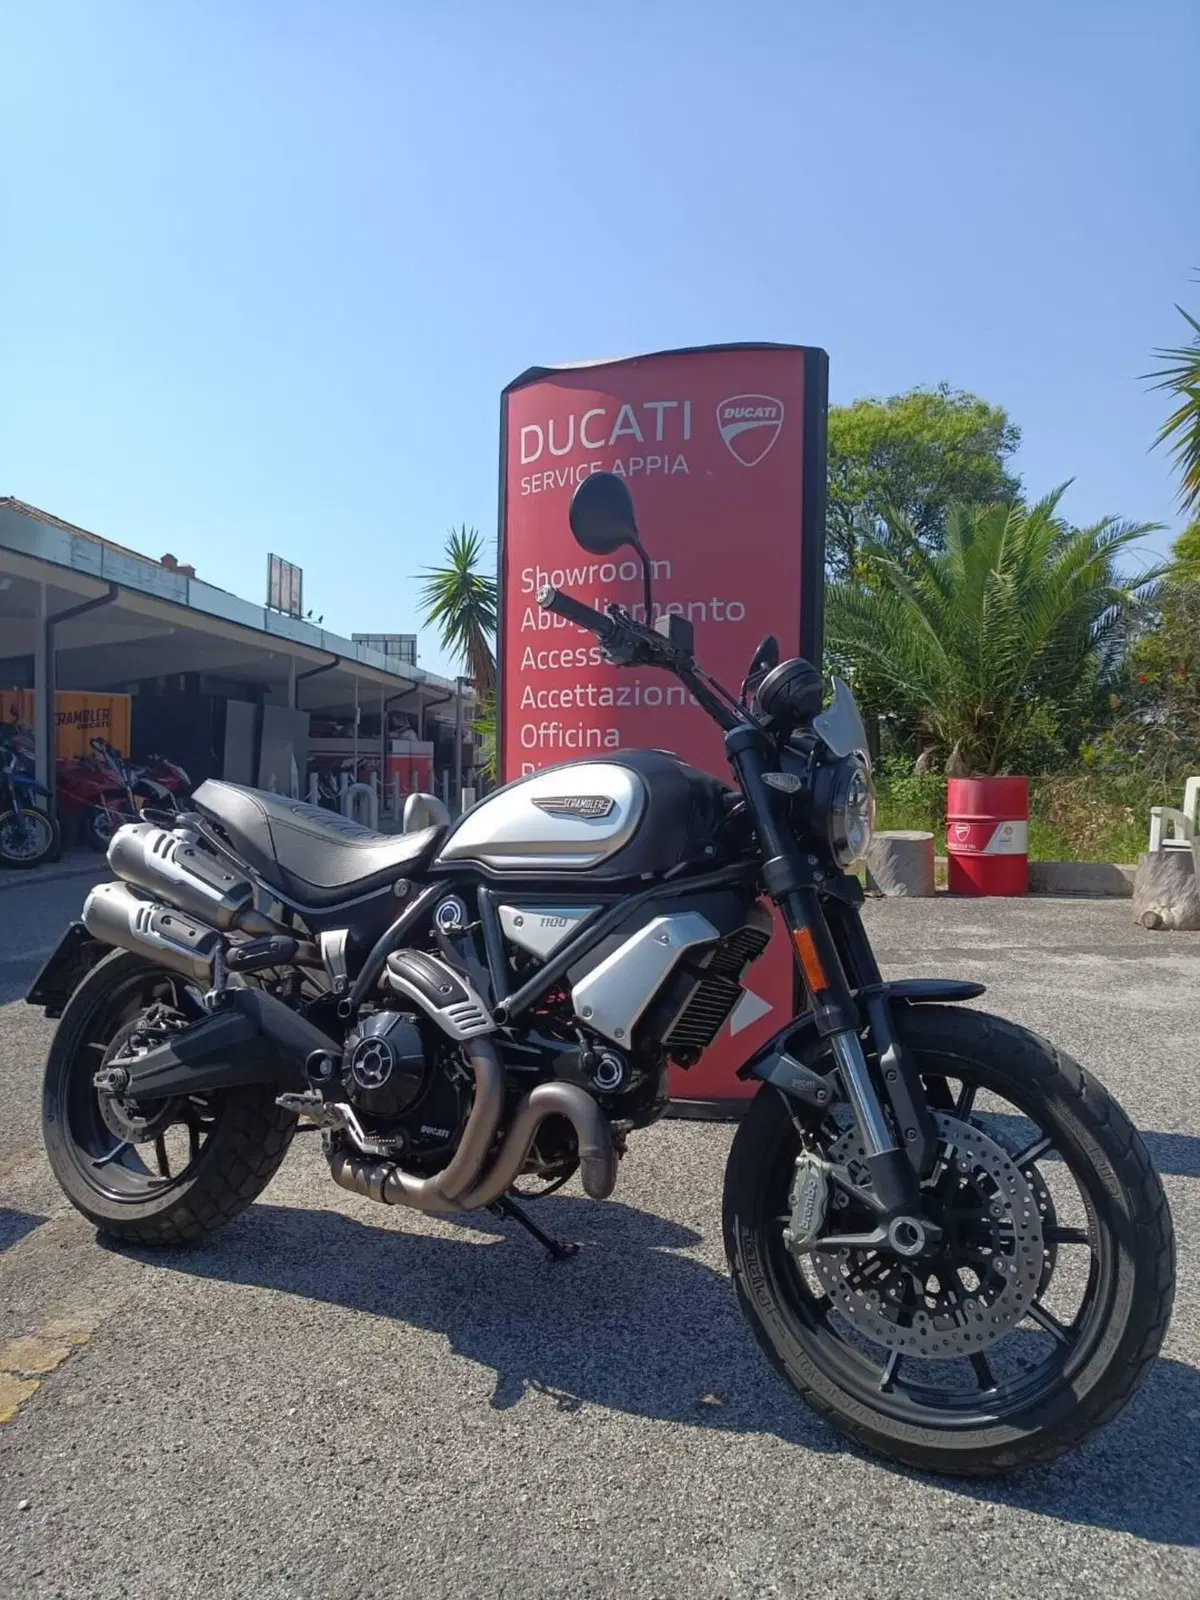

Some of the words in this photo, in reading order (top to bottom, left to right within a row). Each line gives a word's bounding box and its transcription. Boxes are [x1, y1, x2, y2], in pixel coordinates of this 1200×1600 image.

[724, 407, 777, 419] DUCATI
[520, 400, 691, 464] DUCATI
[521, 461, 603, 496] SERVICE
[612, 454, 690, 477] APPIA
[521, 560, 671, 593] Showroom
[520, 721, 620, 748] Officina
[564, 798, 604, 808] SCRAMBLER
[540, 917, 567, 928] 1100
[421, 1125, 449, 1138] DUCATI
[799, 1179, 817, 1231] brembo
